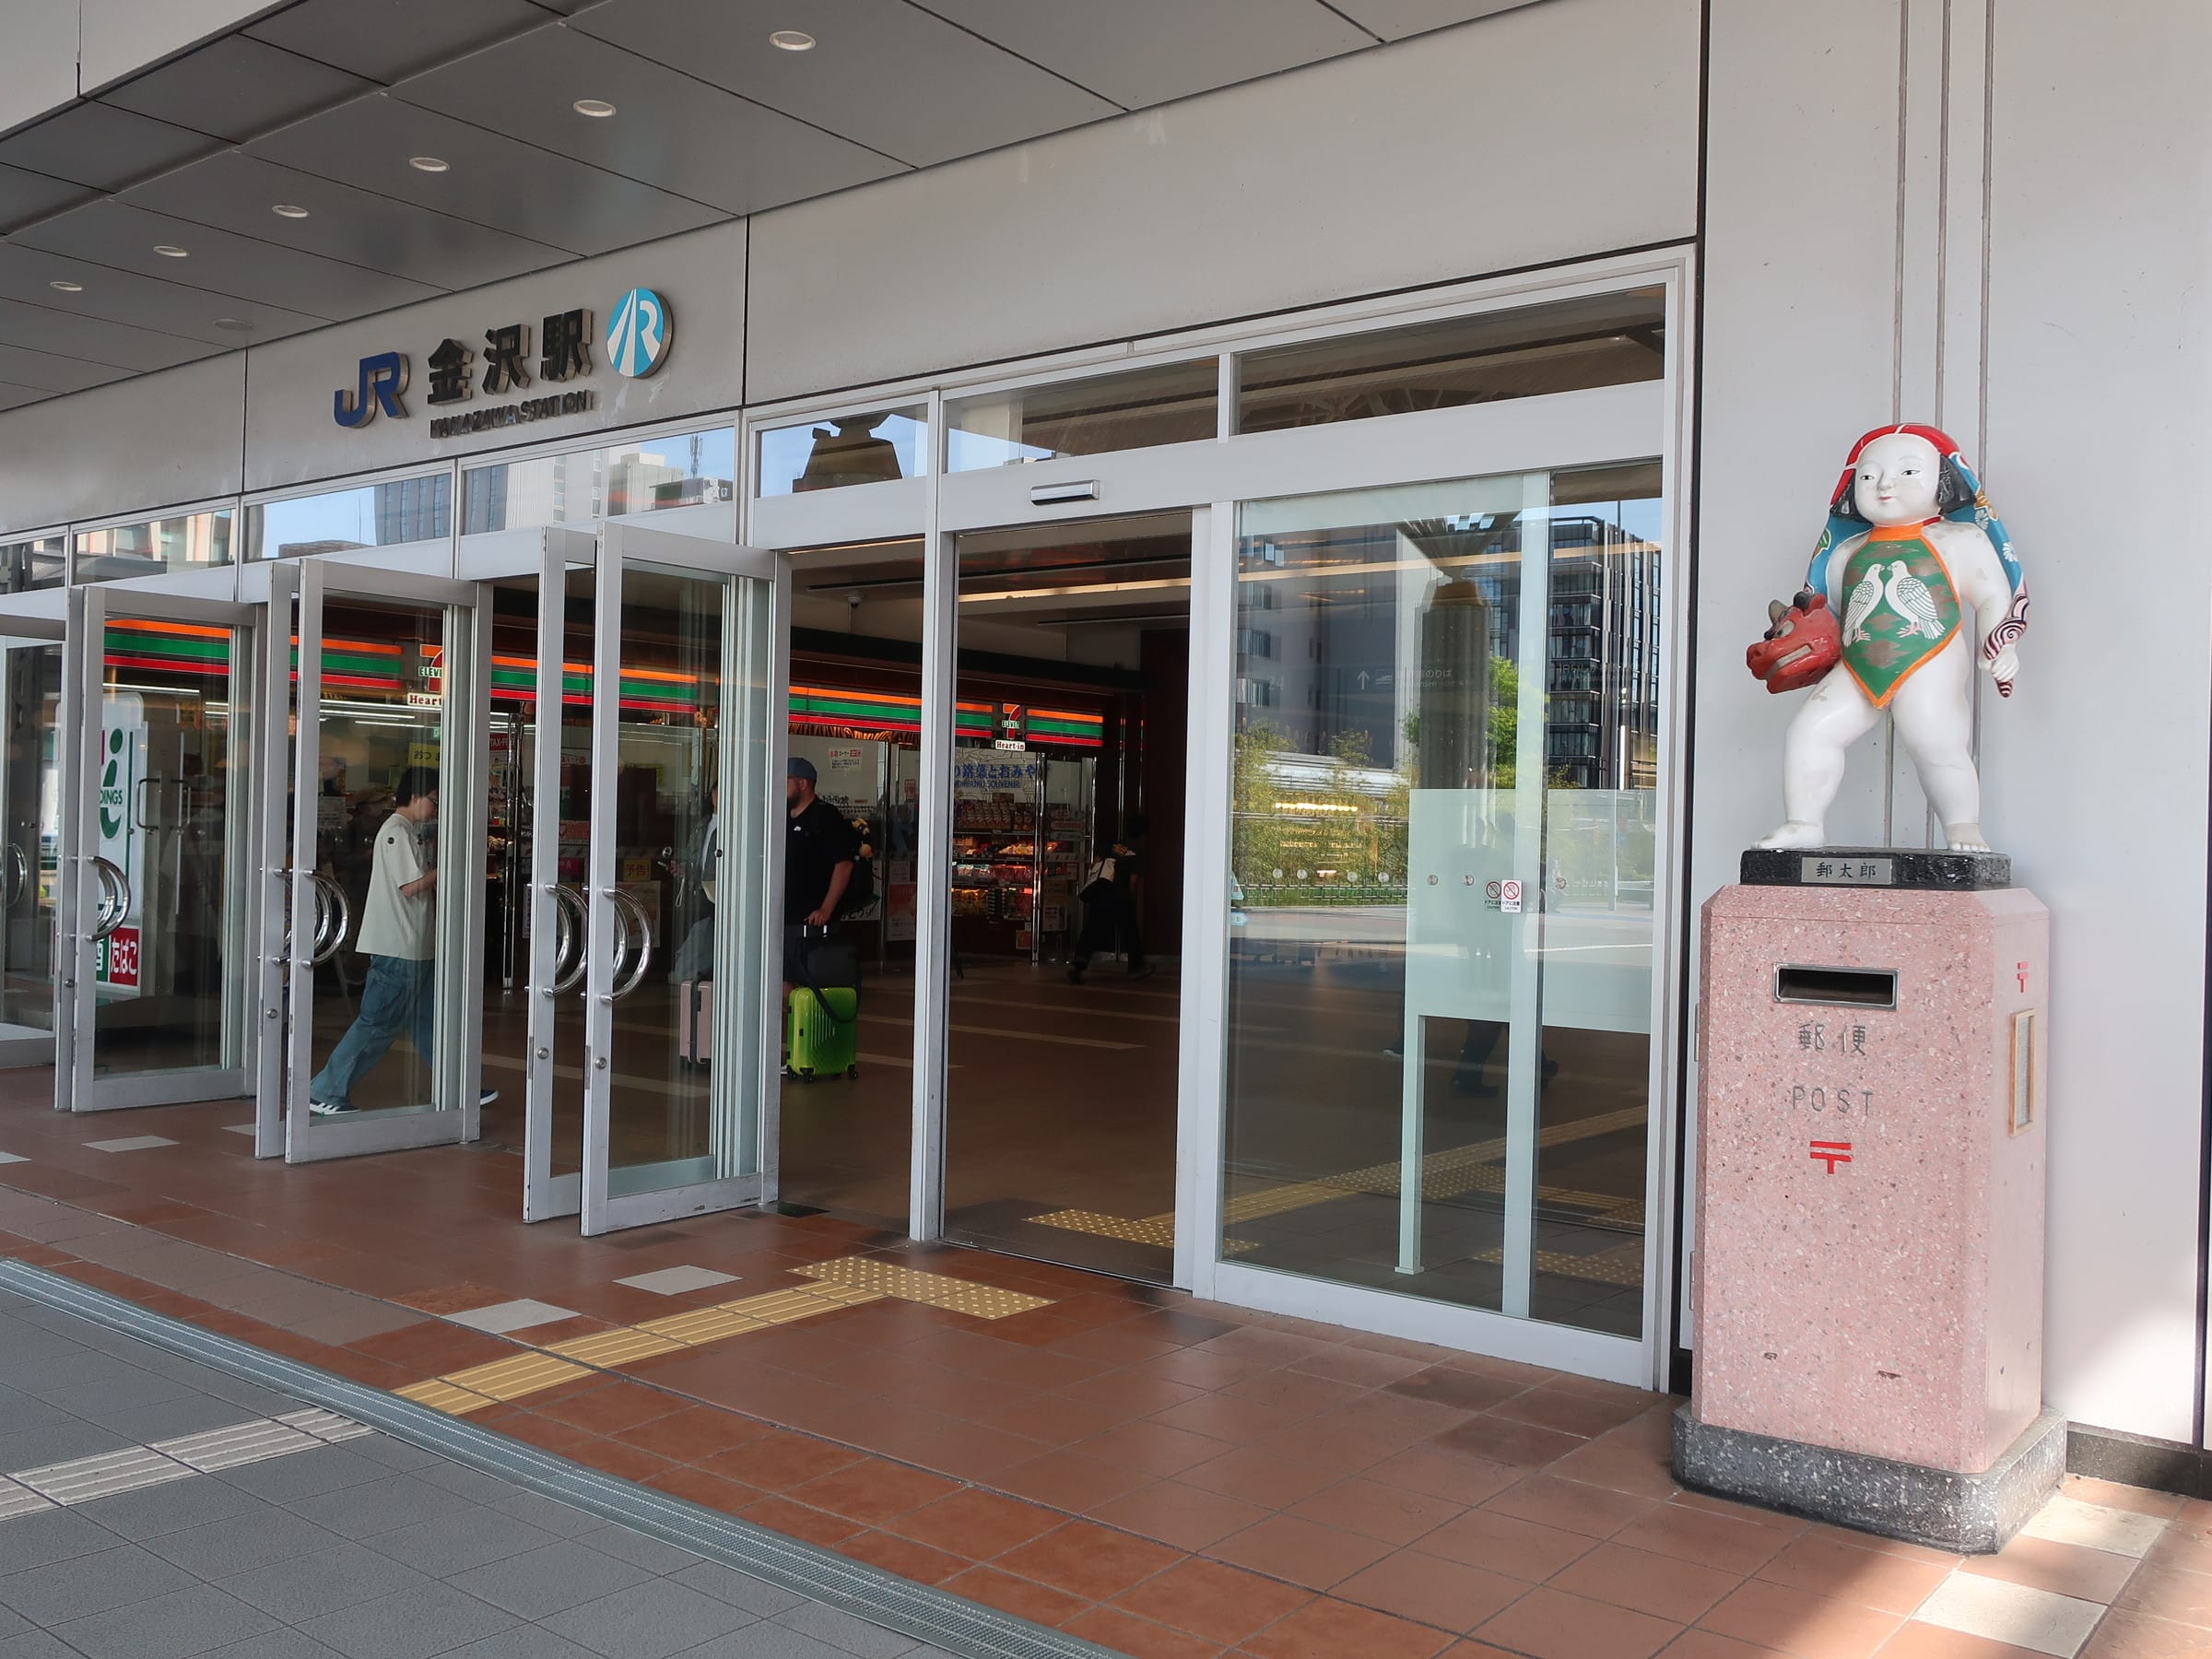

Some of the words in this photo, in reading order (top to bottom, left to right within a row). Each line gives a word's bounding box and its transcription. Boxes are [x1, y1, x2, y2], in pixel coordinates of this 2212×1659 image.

[427, 309, 593, 406] 金沢駅
[335, 351, 409, 428] JR
[430, 405, 522, 438] KANAZAWA
[521, 390, 594, 422] STATION
[1816, 862, 1877, 878] 郵太郎
[111, 938, 137, 975] たばこ
[1798, 1023, 1866, 1056] 郵便
[1793, 1086, 1874, 1116] POST
